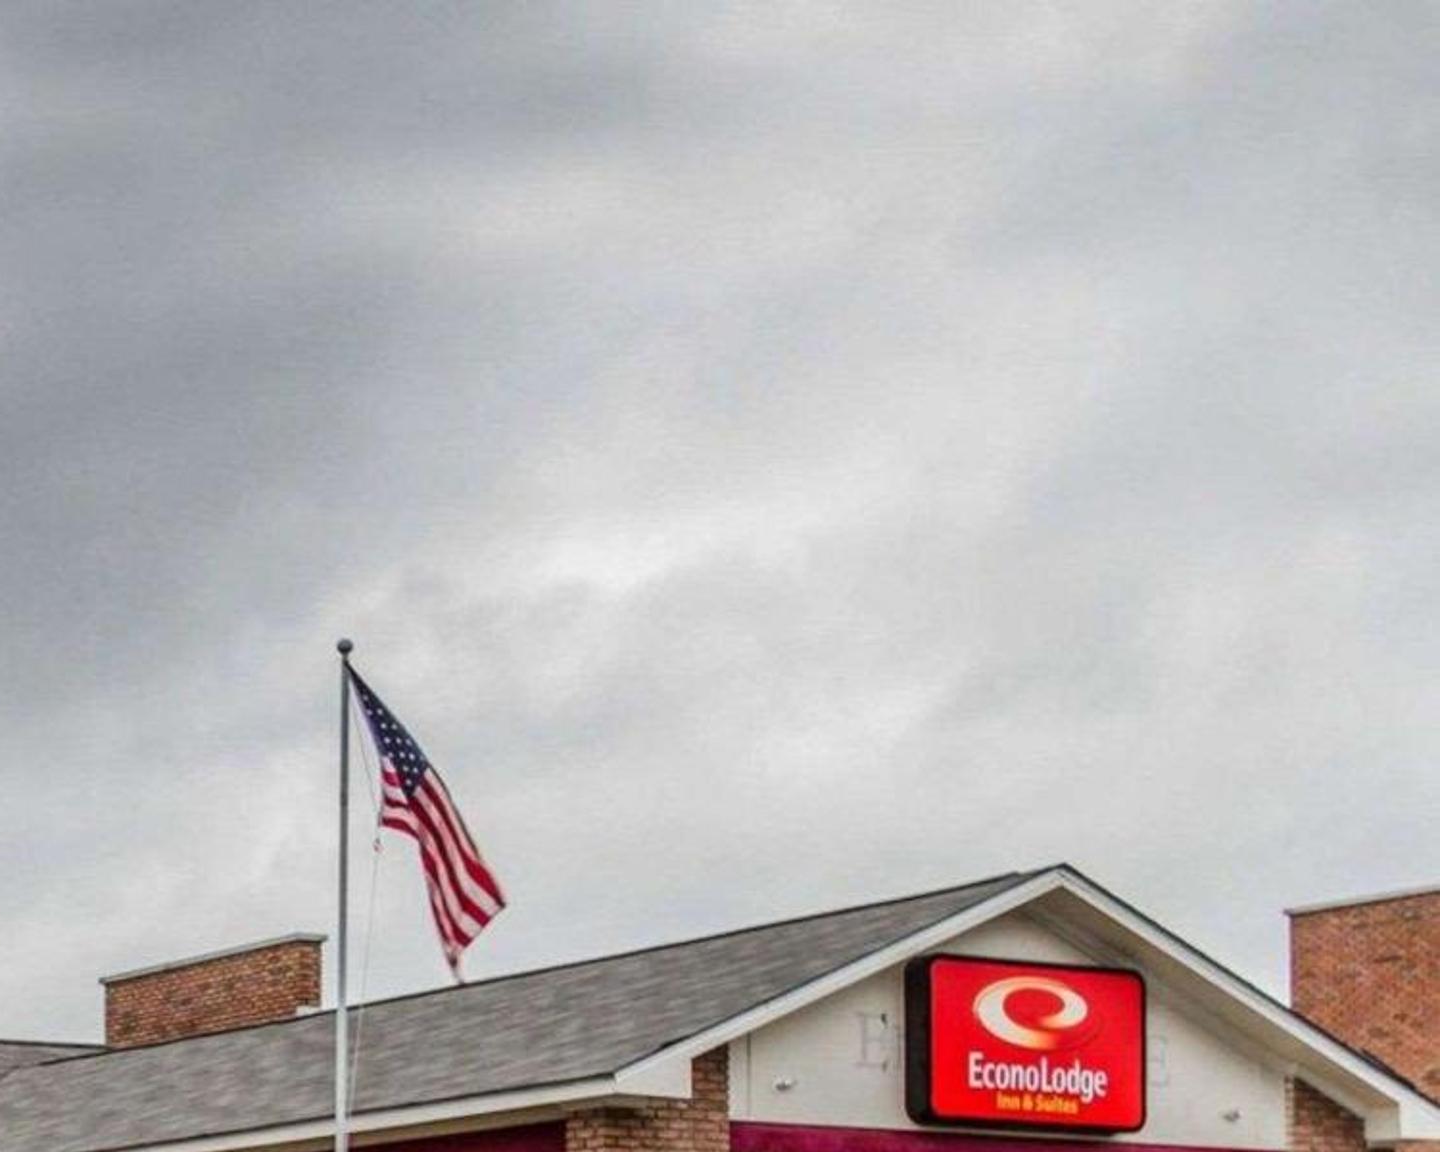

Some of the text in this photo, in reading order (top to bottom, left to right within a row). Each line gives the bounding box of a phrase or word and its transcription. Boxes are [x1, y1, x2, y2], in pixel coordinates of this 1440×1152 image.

[968, 1051, 1108, 1104] EconoLodge
[997, 1092, 1079, 1114] Inn & Suites
